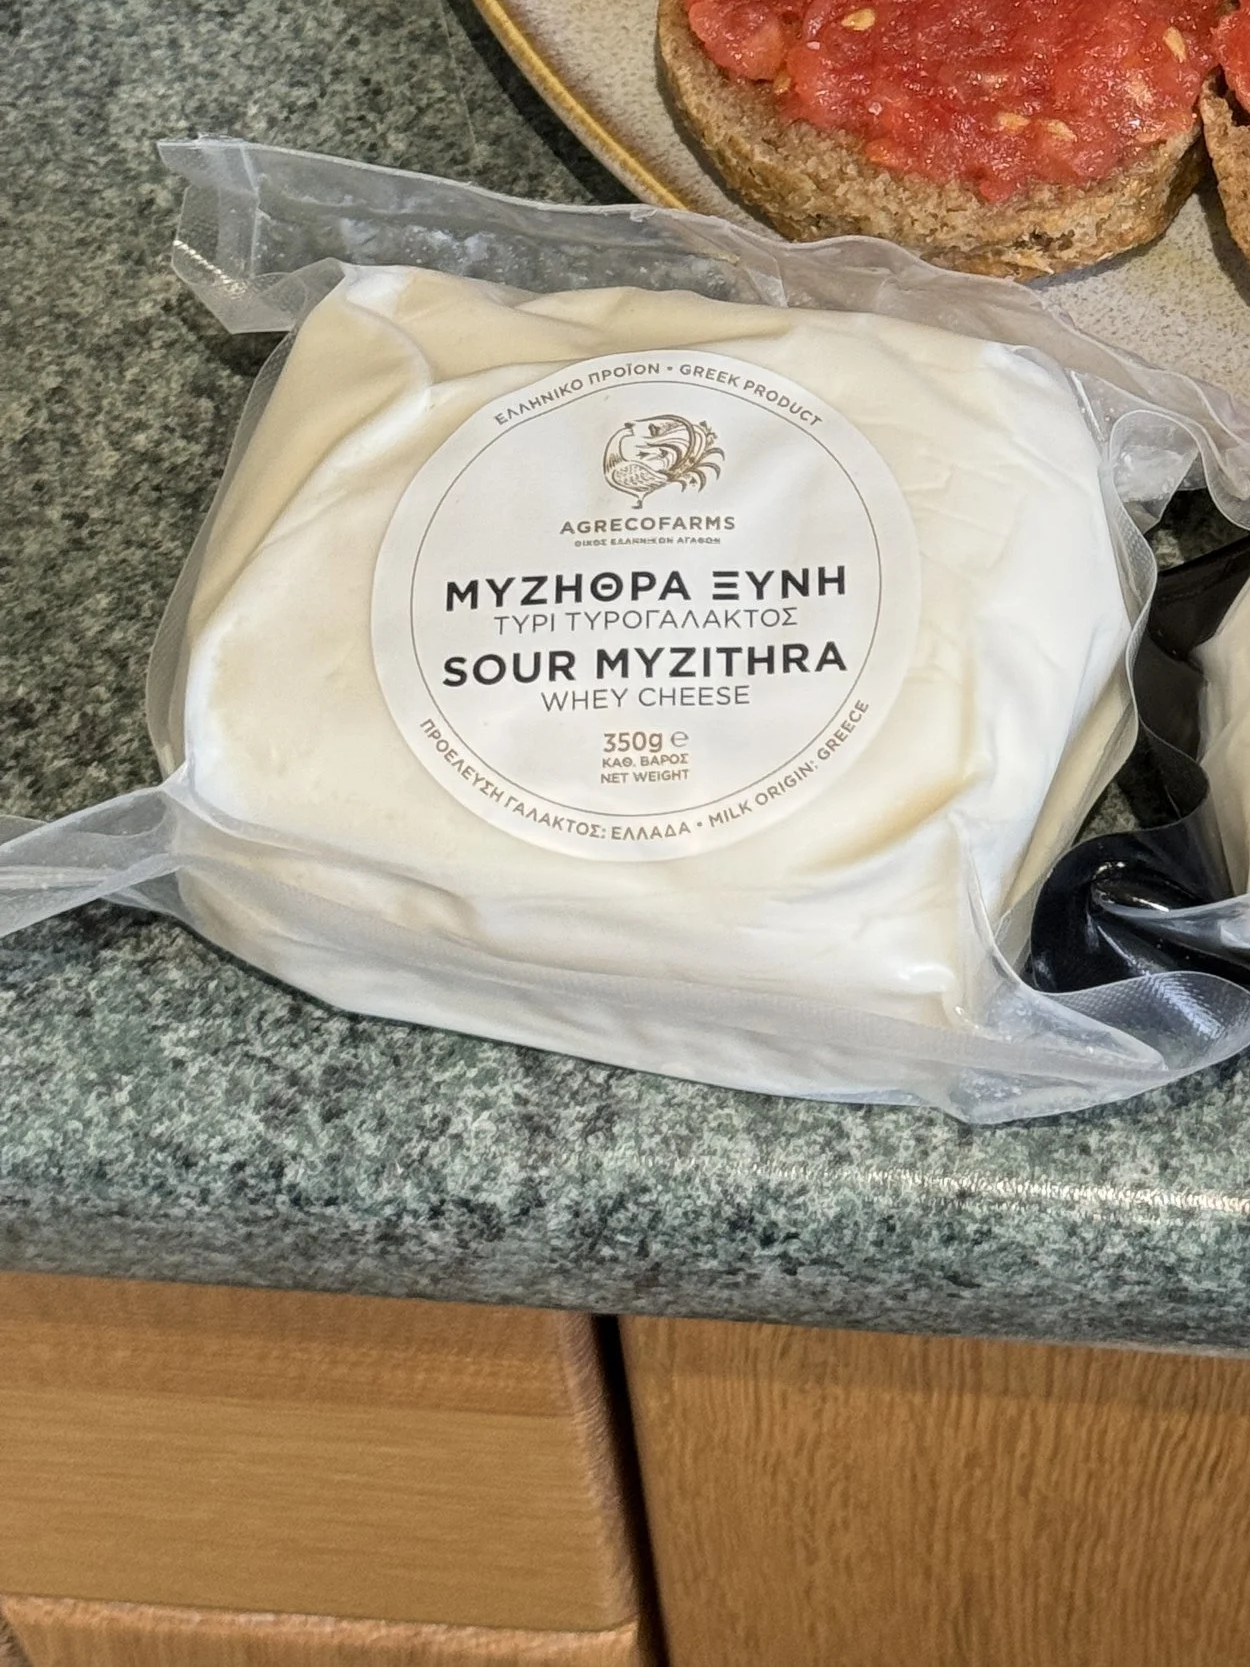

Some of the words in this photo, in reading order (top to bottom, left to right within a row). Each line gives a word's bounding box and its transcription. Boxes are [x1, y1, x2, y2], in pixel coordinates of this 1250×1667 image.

[494, 378, 584, 426] ΕΛΛΗΝΙΚΟ
[679, 364, 741, 388] GREEK
[743, 380, 823, 427] PRODUCT
[559, 515, 735, 535] AGRECOFARMS
[446, 570, 691, 612] ΜΥΖΗΘΡΑ
[711, 565, 847, 602] ΞΥΝΗ
[493, 613, 556, 637] ΤΥΡΙ
[566, 606, 799, 633] ΤΥΡΟΓΑΛΑΚΤΟΣ
[442, 649, 576, 688] SOUR
[595, 641, 848, 681] MYZITHRA
[540, 688, 630, 712] WHEY
[637, 685, 751, 709] CHEESE
[603, 731, 664, 754] 350g
[640, 753, 689, 767] ΒΑΡΟΣ
[418, 718, 504, 804] ΠΡΟΕΛΕΥΣΗ
[503, 795, 607, 839] ΓΑΛΑΚΤΟΣ:
[611, 821, 691, 841] ΕΛΛΑΔΑ
[600, 770, 629, 784] NET
[633, 768, 690, 783] WEIGHT
[708, 800, 752, 828] MILK
[755, 759, 819, 807] ORIGIN:
[816, 698, 870, 762] GREECE
